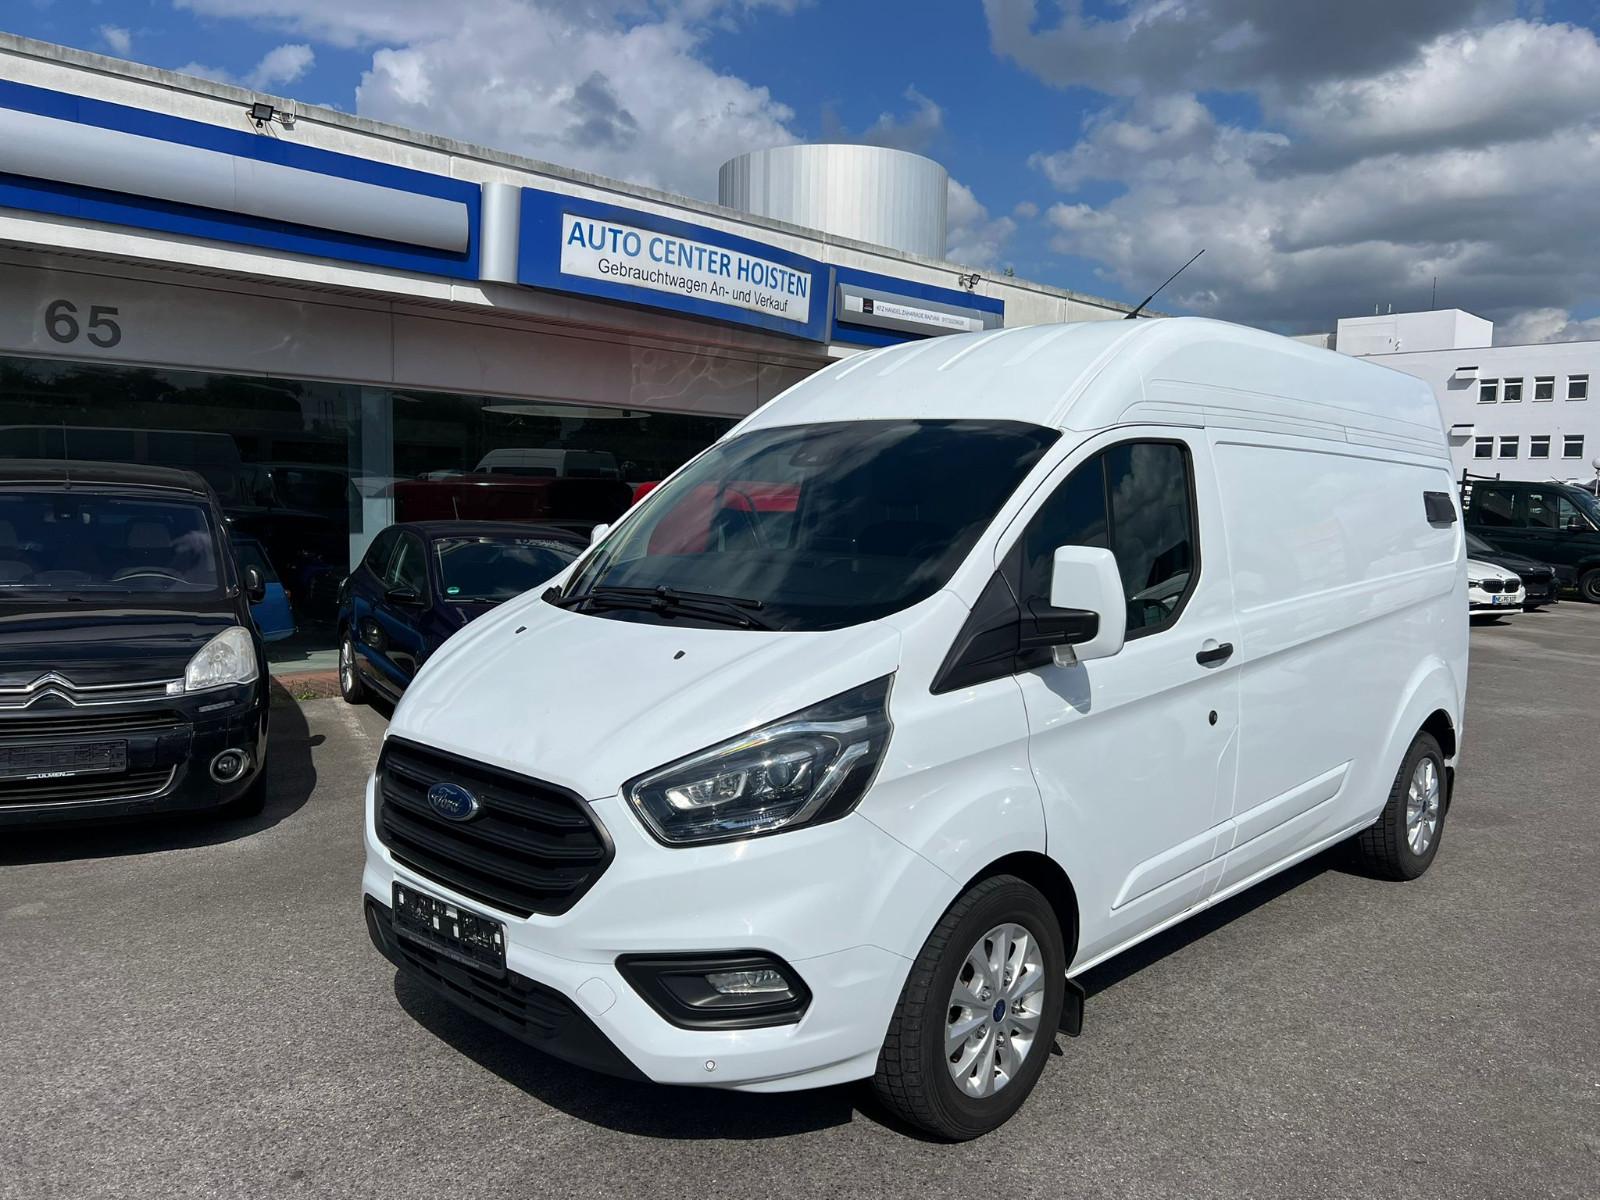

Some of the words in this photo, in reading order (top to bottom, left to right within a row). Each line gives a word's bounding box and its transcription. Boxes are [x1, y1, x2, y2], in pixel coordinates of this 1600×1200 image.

[567, 221, 641, 257] AUTO
[649, 237, 731, 278] CENTER
[737, 257, 807, 298] HOISTEN
[598, 258, 708, 294] Gebrauchtwagen
[709, 281, 730, 297] An-
[732, 289, 751, 303] und
[754, 290, 789, 313] Verkauf
[45, 299, 122, 348] 65
[431, 787, 461, 813] Ford
